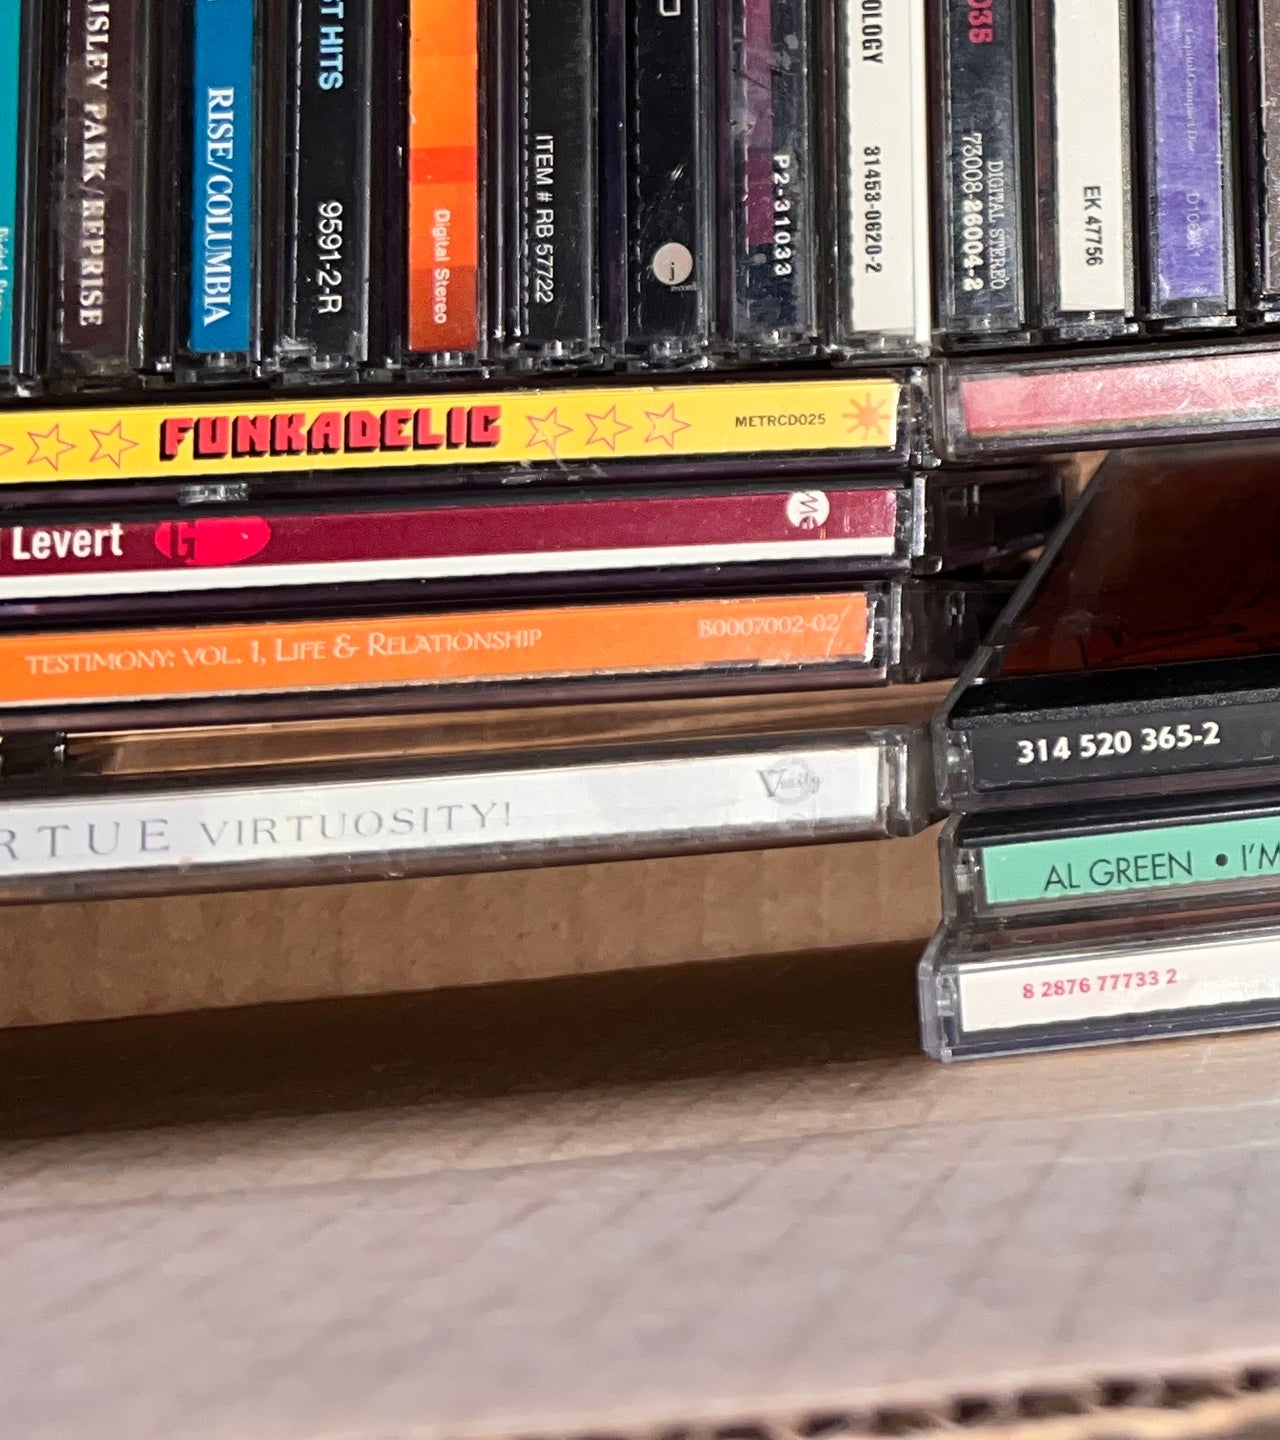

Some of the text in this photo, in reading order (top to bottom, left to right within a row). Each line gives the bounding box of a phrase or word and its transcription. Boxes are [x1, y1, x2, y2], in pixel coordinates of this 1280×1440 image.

[318, 25, 343, 90] HITS
[79, 103, 107, 326] PARK/REPRISE
[202, 86, 233, 327] RISE/COLUMBIA
[533, 135, 554, 303] ITEM 57722
[771, 155, 791, 277] P2-31033
[862, 146, 883, 275] 31453-0620-2
[961, 132, 983, 291] 73008-26004-2
[316, 201, 343, 313] 9591-2-R
[431, 209, 451, 324] Digital Stereo
[1084, 215, 1105, 266] 47756
[160, 404, 501, 458] FUNKADELIC
[735, 413, 826, 428] METRCD025
[12, 522, 123, 559] Levert
[1142, 722, 1220, 751] 365-2
[204, 801, 512, 850] VIRTUOSITY!
[1090, 851, 1193, 886] GREEN
[1096, 971, 1160, 993] 77733
